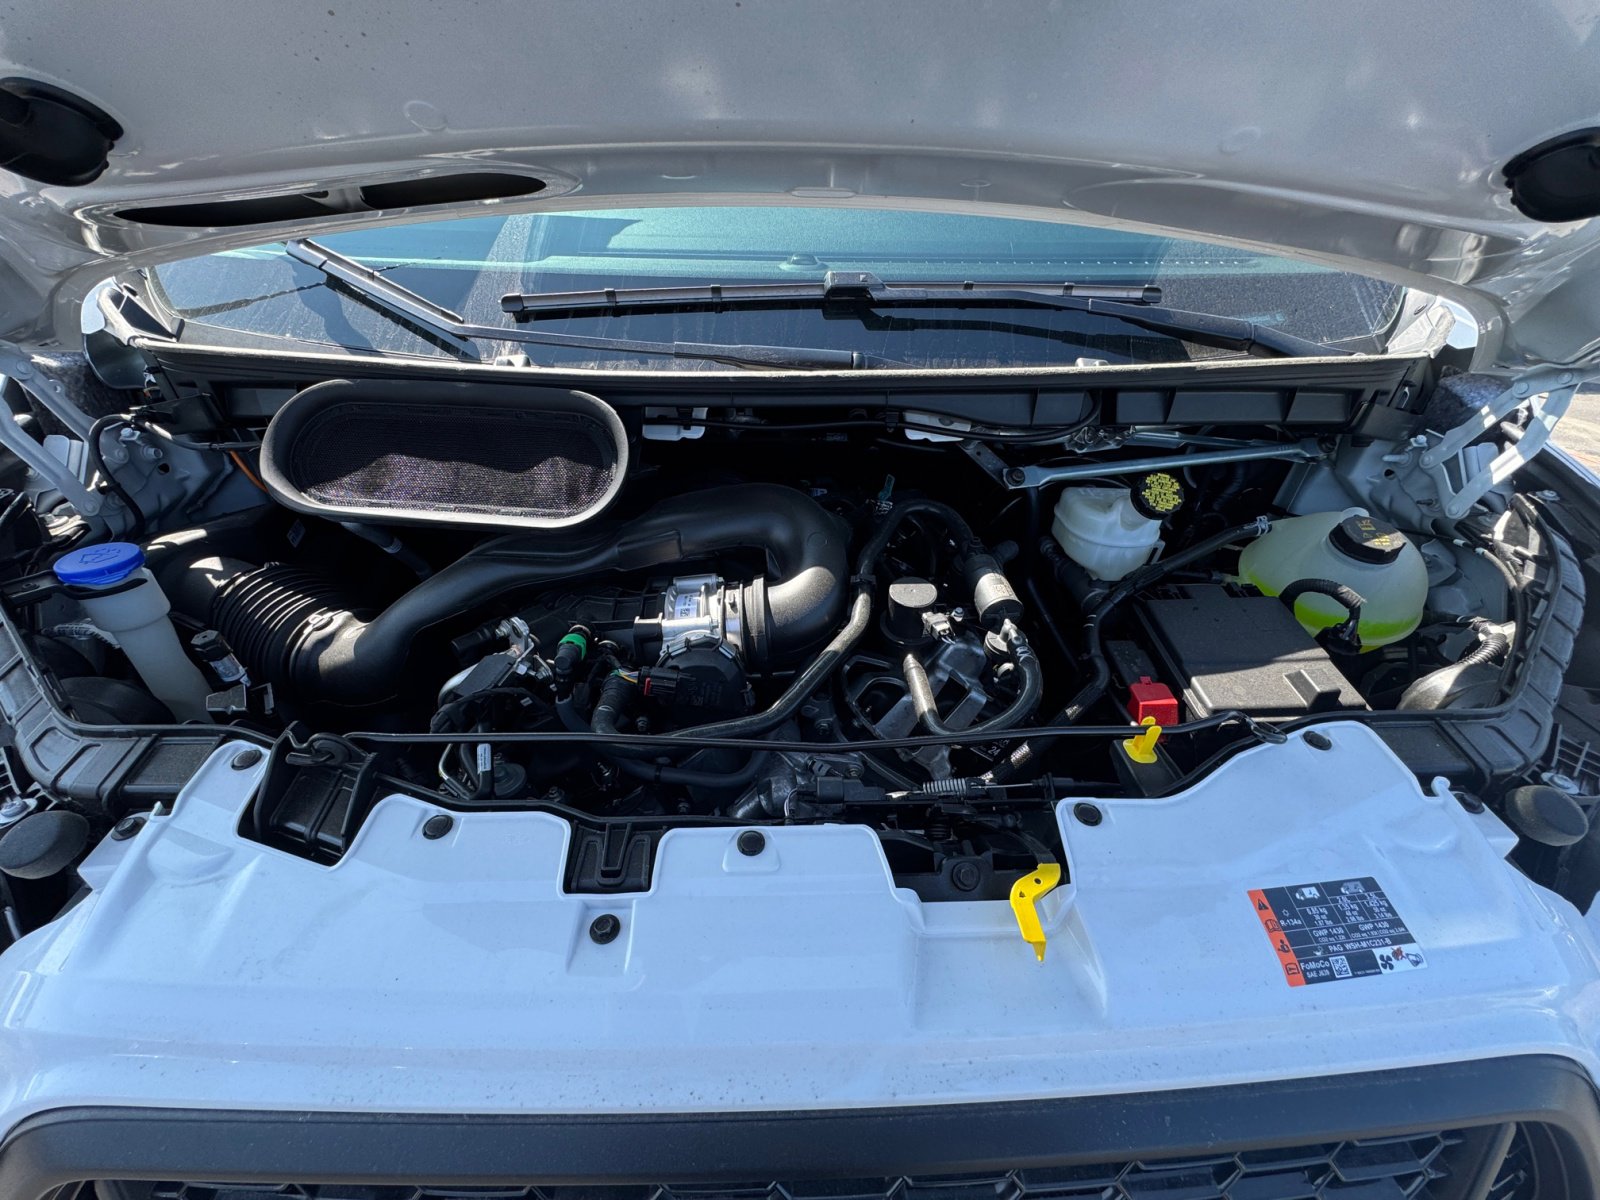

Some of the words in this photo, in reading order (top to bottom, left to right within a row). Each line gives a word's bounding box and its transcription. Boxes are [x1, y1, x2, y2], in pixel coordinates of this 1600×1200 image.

[1349, 903, 1359, 911] kg
[1378, 899, 1388, 907] kg
[1319, 907, 1328, 915] kg
[1280, 918, 1302, 927] R-134a
[1358, 923, 1373, 931] GWP
[1374, 920, 1389, 928] 1430
[1312, 929, 1328, 937] GWP
[1329, 926, 1344, 934] 1430
[1328, 944, 1344, 952] PAG
[1300, 960, 1330, 970] FoMoCo
